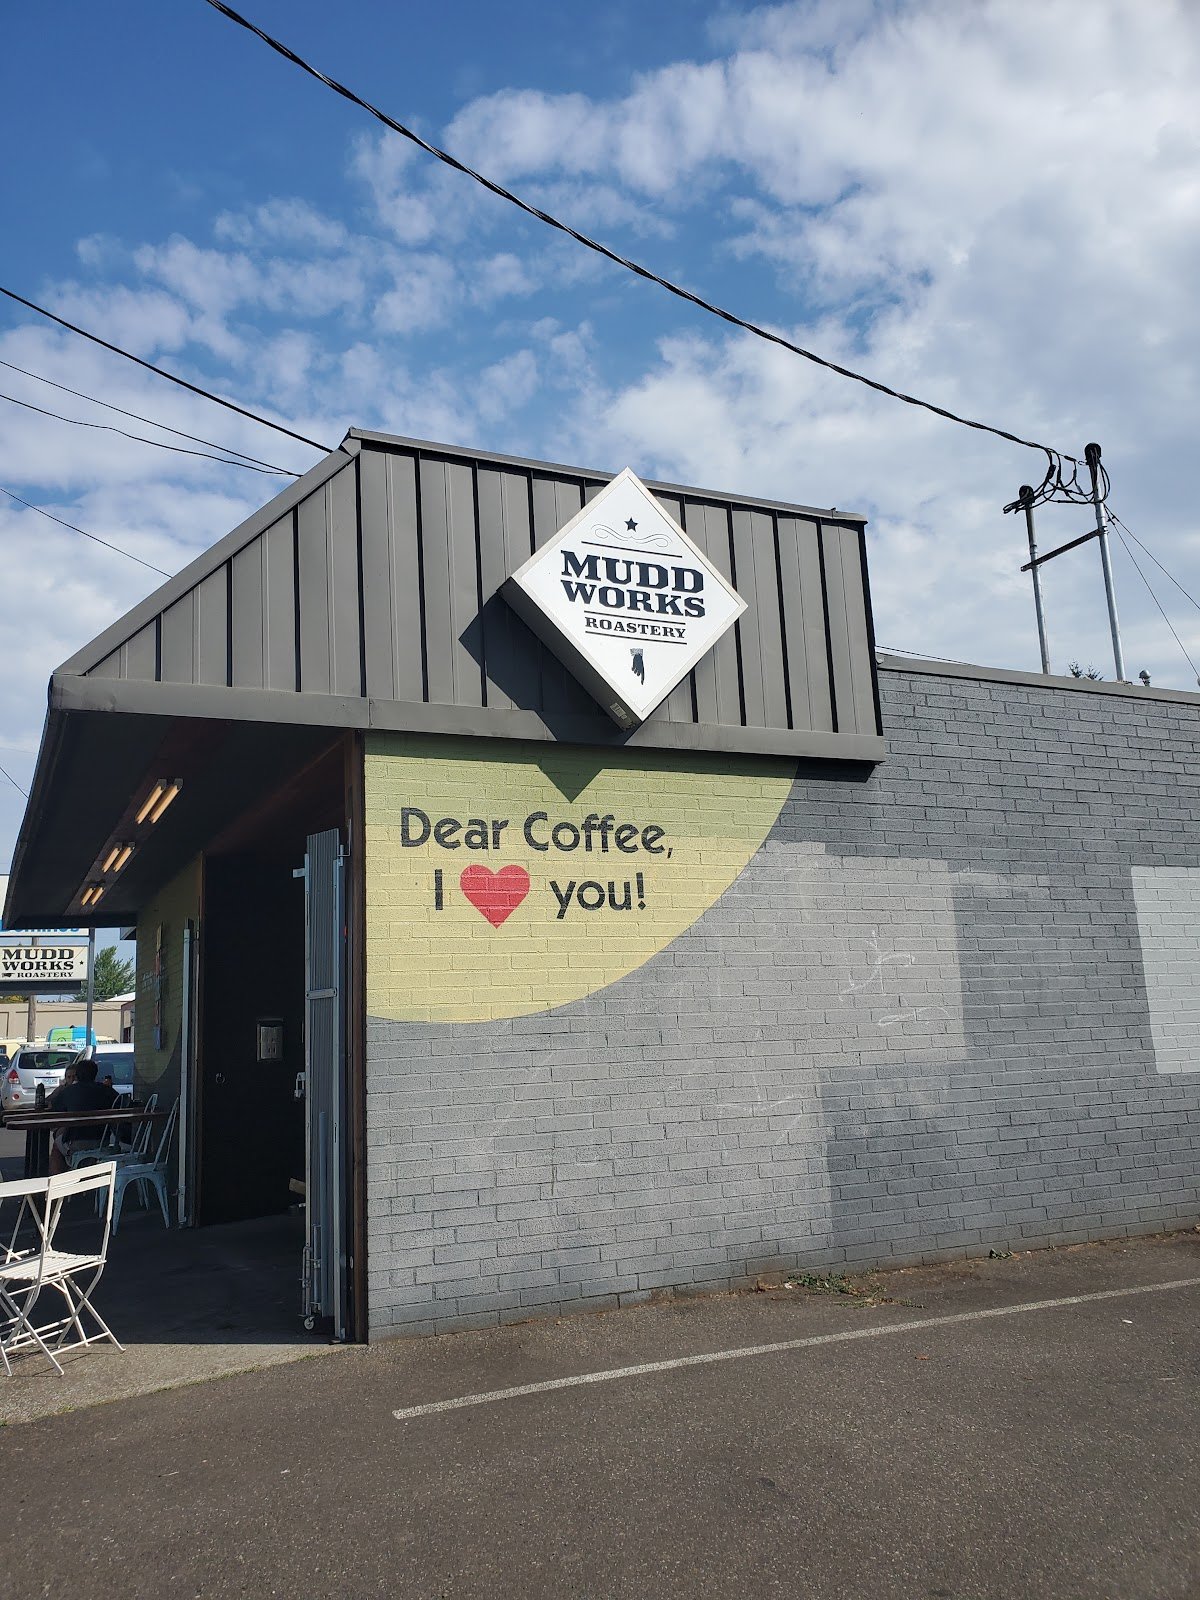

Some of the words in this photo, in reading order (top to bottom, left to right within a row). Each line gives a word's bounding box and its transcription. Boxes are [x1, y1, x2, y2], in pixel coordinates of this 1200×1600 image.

[560, 550, 704, 594] MUDD
[560, 580, 705, 618] WORKS
[585, 616, 686, 639] ROASTERY
[400, 807, 509, 850] Dear
[523, 811, 673, 858] Coffee,
[434, 868, 443, 910] I
[550, 872, 646, 919] you!
[2, 948, 74, 960] MUDD
[2, 961, 74, 971] WORKS
